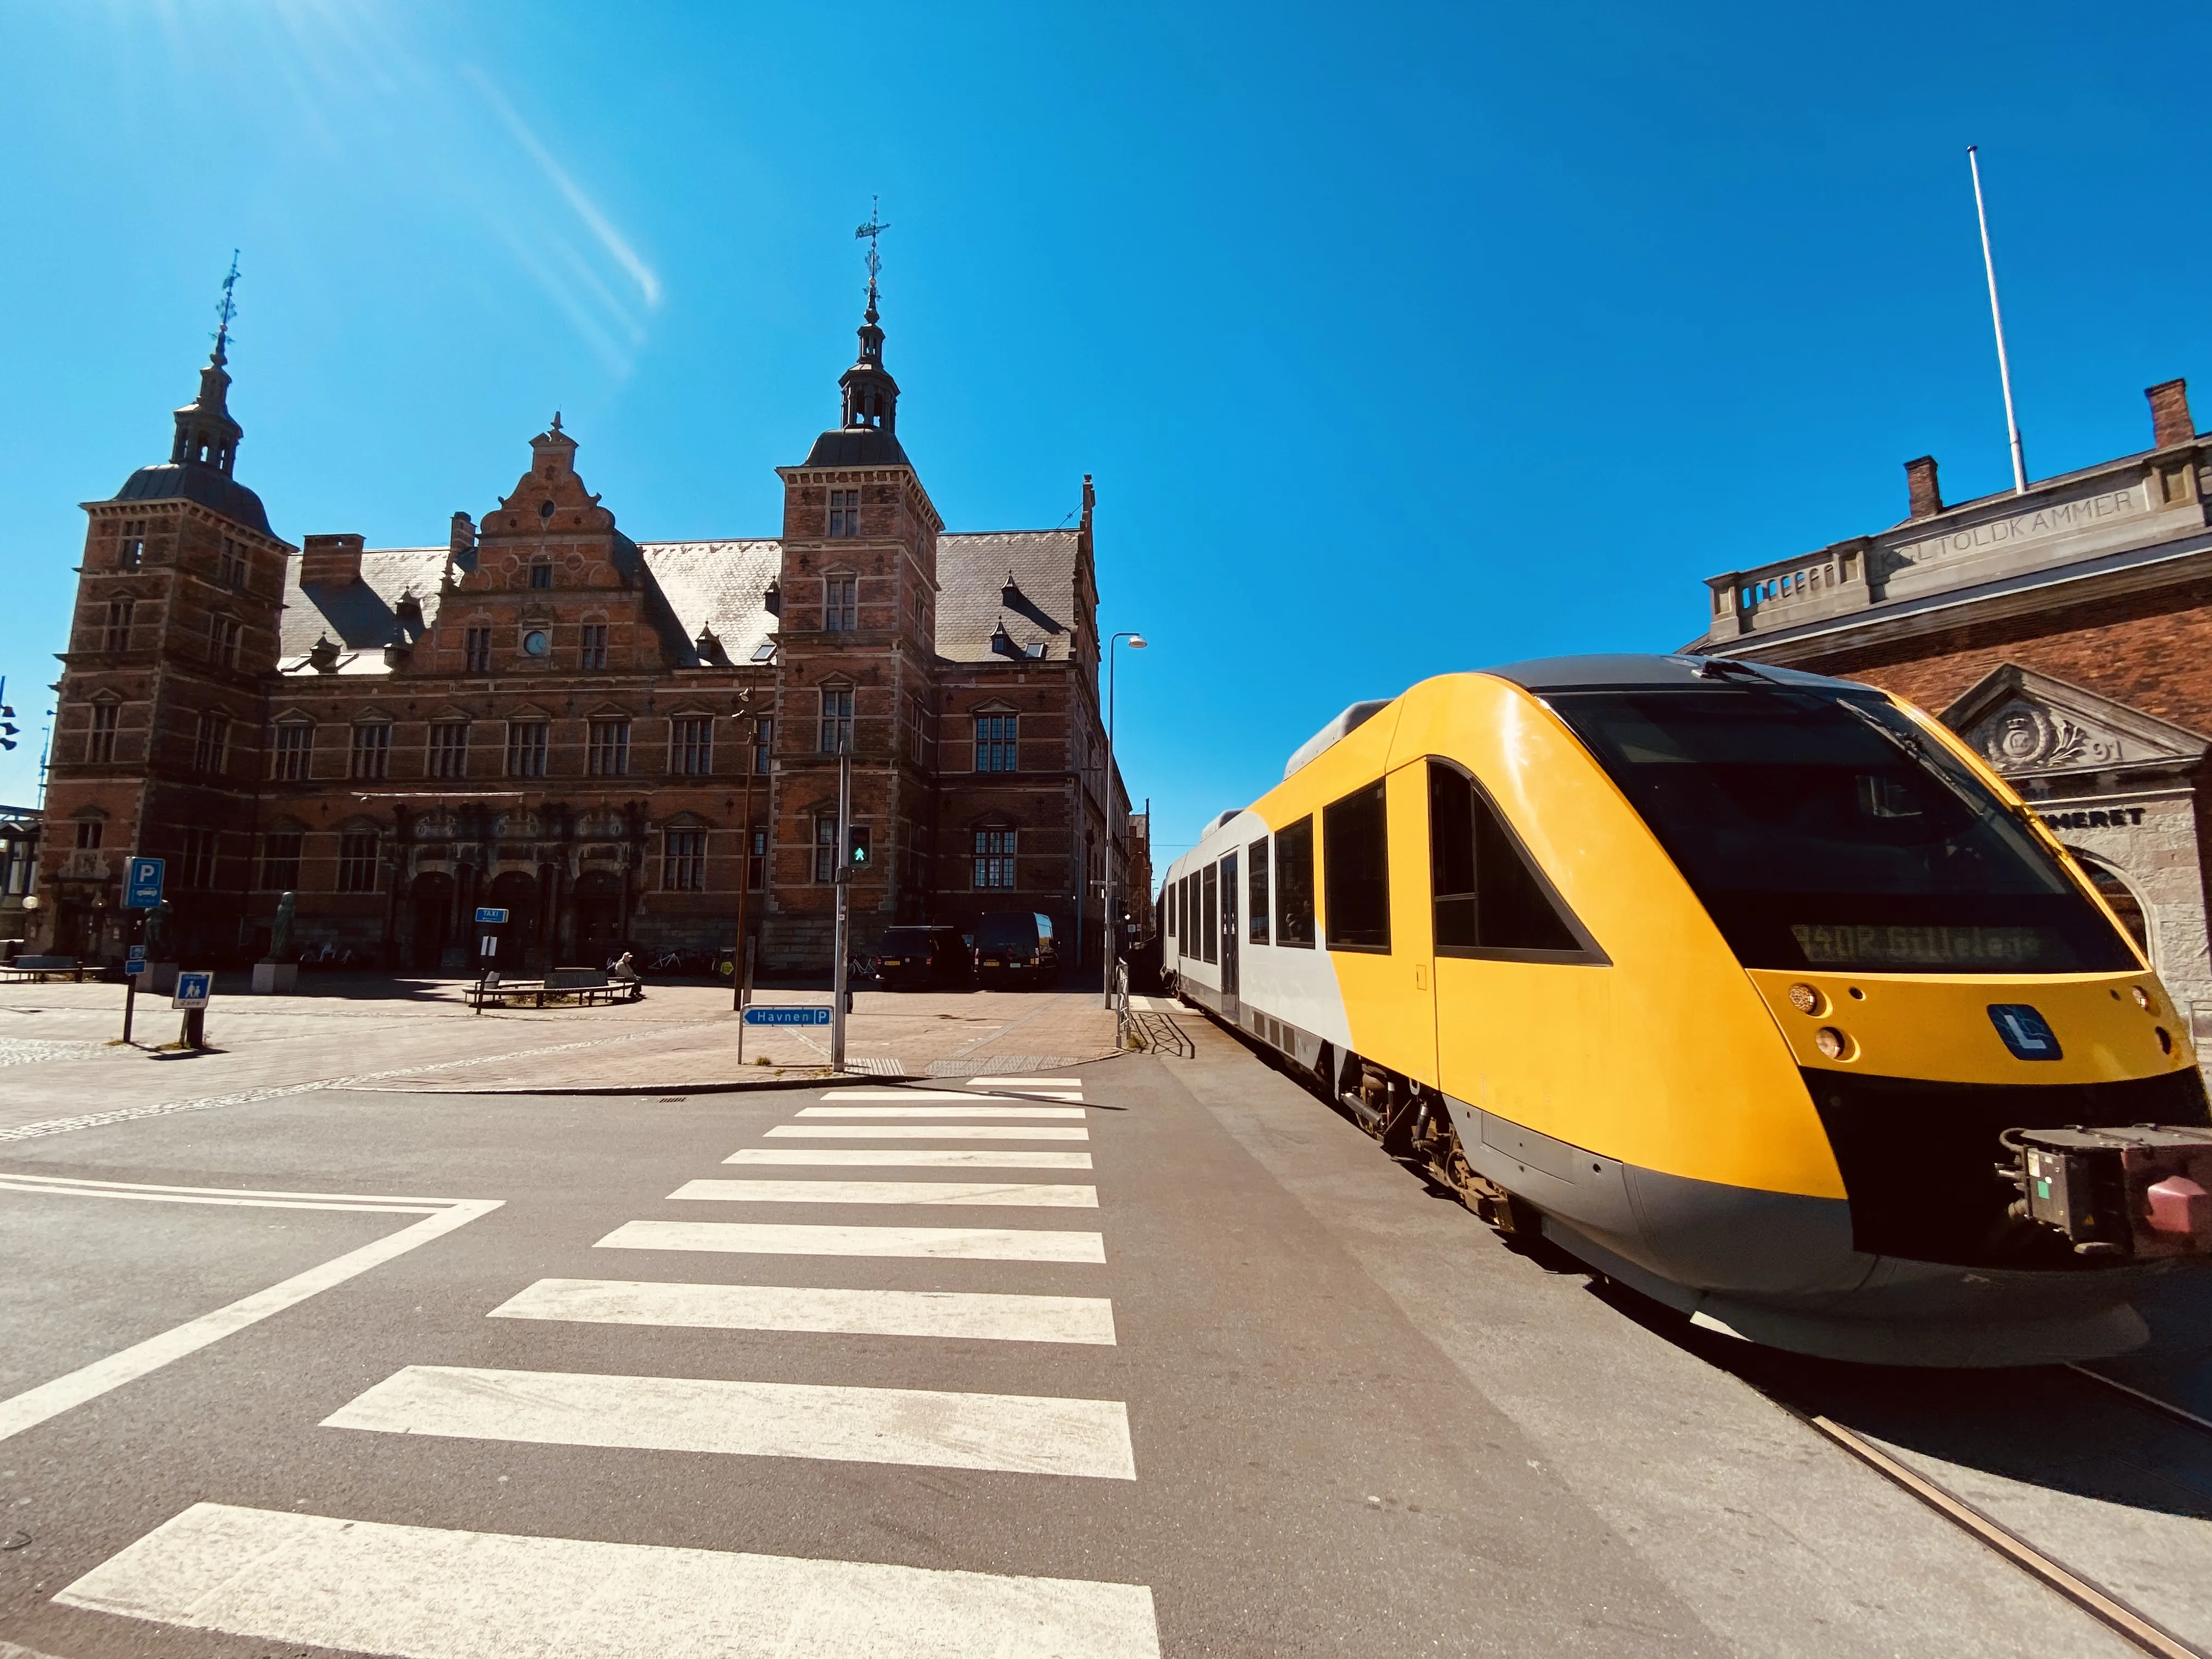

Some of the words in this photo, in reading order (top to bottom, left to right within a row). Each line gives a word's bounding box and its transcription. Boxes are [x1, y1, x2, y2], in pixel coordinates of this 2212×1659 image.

[139, 865, 154, 882] P
[758, 1012, 808, 1022] Havnen
[819, 1011, 826, 1023] P
[2004, 1015, 2047, 1049] L
